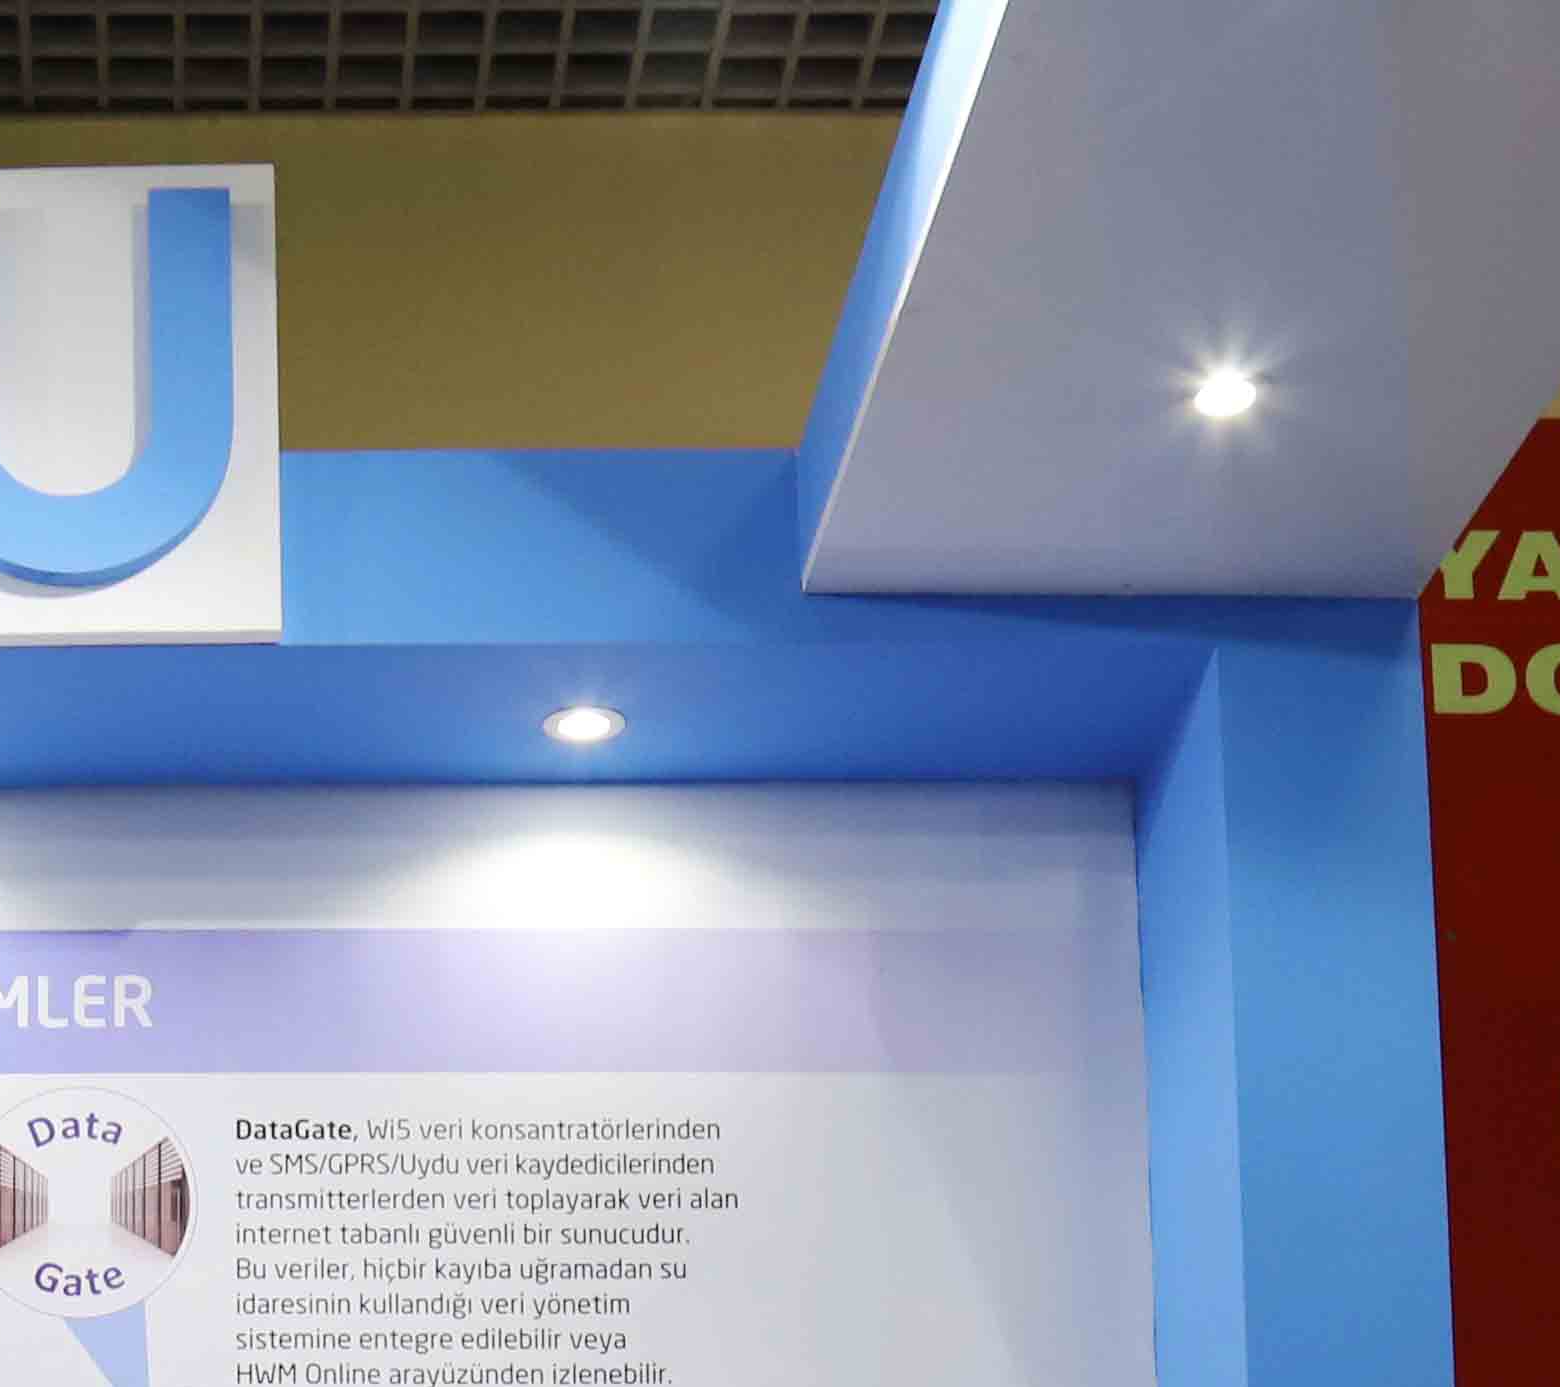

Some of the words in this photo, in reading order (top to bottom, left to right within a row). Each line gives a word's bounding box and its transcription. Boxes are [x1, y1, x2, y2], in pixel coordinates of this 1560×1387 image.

[27, 1112, 124, 1148] Data
[235, 1117, 359, 1143] DataGate,
[366, 1118, 411, 1141] Wi5
[419, 1118, 463, 1141] veri
[471, 1117, 721, 1141] konsantratörlerinden
[235, 1157, 264, 1176] ve
[269, 1151, 460, 1181] SMS/GPRS/Uydu
[466, 1152, 509, 1176] veri
[515, 1151, 715, 1181] kaydedicilerinden
[234, 1187, 445, 1211] transmitterlerden
[453, 1187, 497, 1210] veri
[503, 1187, 630, 1216] toplayarak
[637, 1186, 682, 1210] veri
[689, 1186, 739, 1210] alan
[235, 1222, 332, 1246] internet
[339, 1222, 420, 1246] tabanlı
[428, 1221, 515, 1250] güvenli
[523, 1222, 553, 1246] bir
[560, 1221, 691, 1247] sunucudur.
[34, 1263, 126, 1297] Gate
[236, 1257, 267, 1281] Bu
[274, 1257, 355, 1281] veriler,
[363, 1256, 427, 1286] hiçbir
[434, 1256, 512, 1286] kayıba
[519, 1257, 653, 1286] uğramadan
[660, 1261, 687, 1280] su
[235, 1292, 352, 1316] idaresinin
[359, 1292, 473, 1321] kullandığı
[480, 1291, 525, 1316] veri
[532, 1291, 631, 1321] yönetim
[235, 1327, 352, 1351] sistemine
[359, 1329, 454, 1356] entegre
[460, 1327, 563, 1351] edilebilir
[569, 1332, 627, 1356] veya
[236, 1362, 297, 1385] HWM
[305, 1362, 381, 1385] Online
[551, 1359, 673, 1385] izlenebilir.
